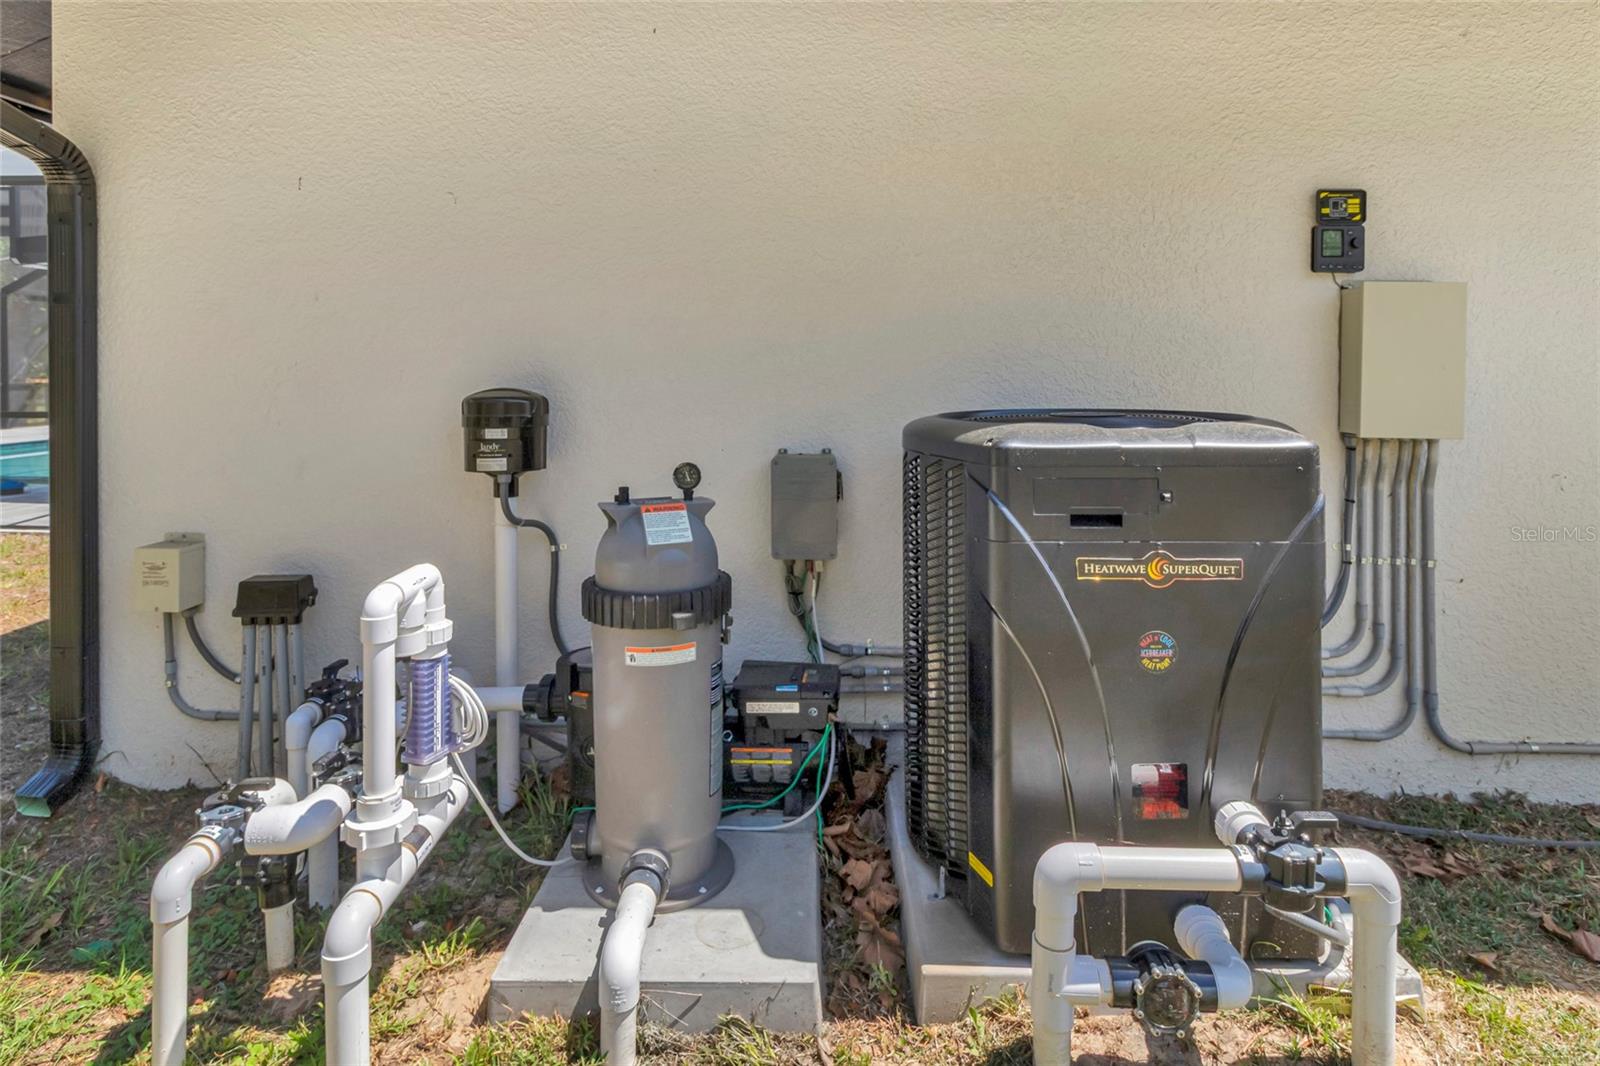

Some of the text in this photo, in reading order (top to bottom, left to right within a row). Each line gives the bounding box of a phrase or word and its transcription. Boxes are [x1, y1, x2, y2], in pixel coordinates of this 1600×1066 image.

[1084, 563, 1146, 574] HEATWAVE
[1140, 634, 1153, 648] HEAT
[1141, 657, 1171, 670] HEAT PUMP
